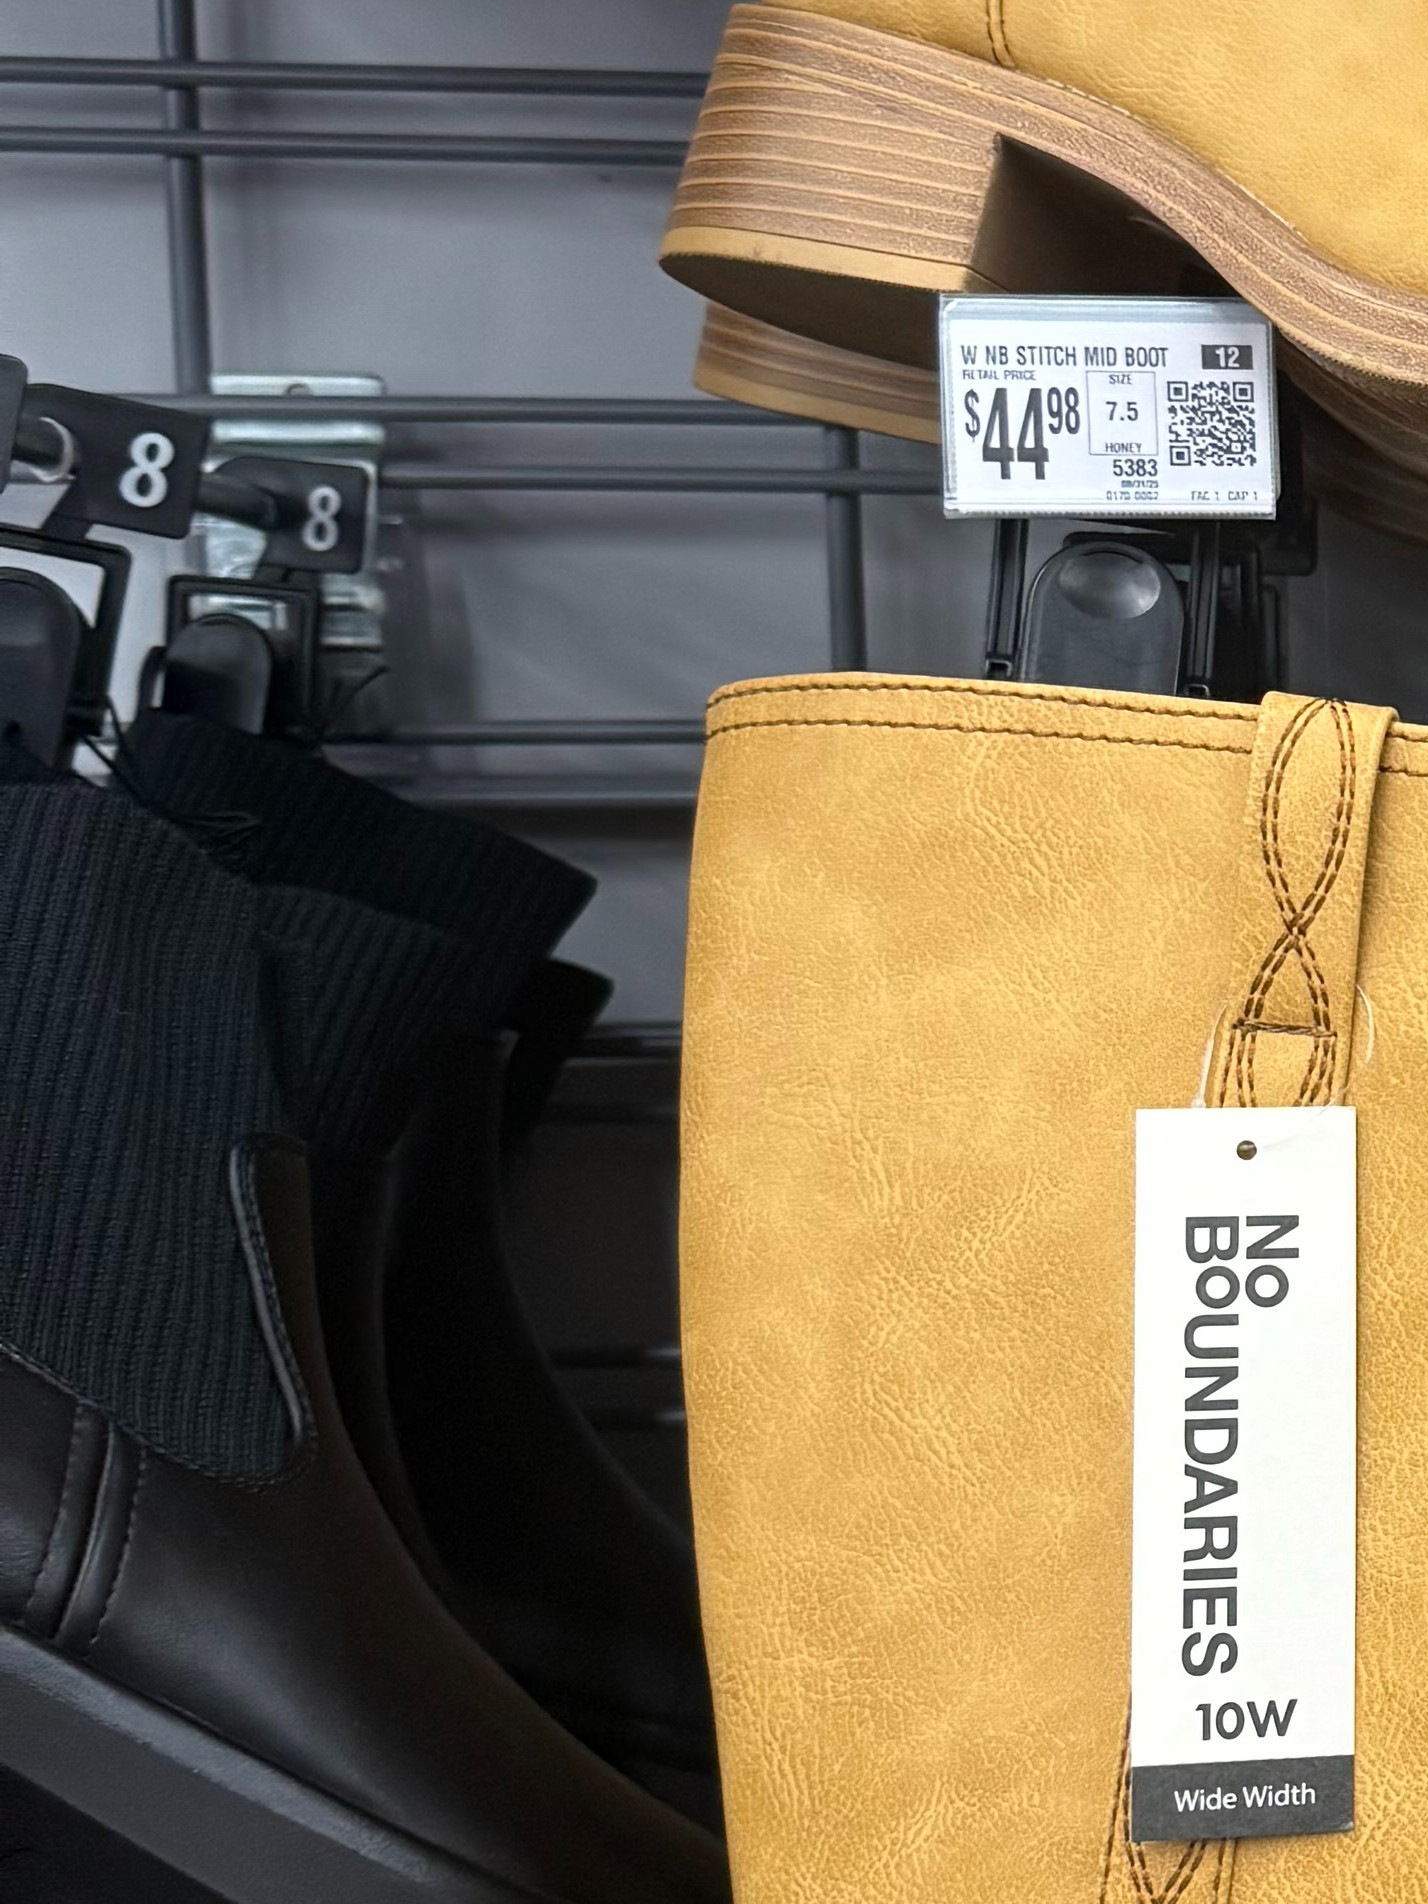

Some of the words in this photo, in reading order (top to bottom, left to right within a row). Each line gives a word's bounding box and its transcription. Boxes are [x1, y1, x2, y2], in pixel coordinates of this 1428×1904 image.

[960, 345, 978, 365] W
[986, 345, 1009, 366] NB
[1016, 345, 1077, 366] STITCH
[1084, 346, 1118, 367] MID
[1125, 346, 1169, 368] BOOT
[1214, 347, 1241, 368] 12
[962, 369, 1000, 381] RETAIL
[1004, 369, 1037, 381] PRICE
[1108, 373, 1133, 385] SIZE
[1105, 401, 1139, 422] 7.5
[1105, 442, 1143, 454] HONEY
[119, 432, 175, 508] 8
[1112, 458, 1158, 477] 5383
[302, 485, 342, 552] 8
[1181, 1214, 1241, 1678] BOUNDARIES
[1195, 1697, 1298, 1743] 10W
[1173, 1783, 1238, 1814] Wide
[1241, 1782, 1317, 1810] Width
